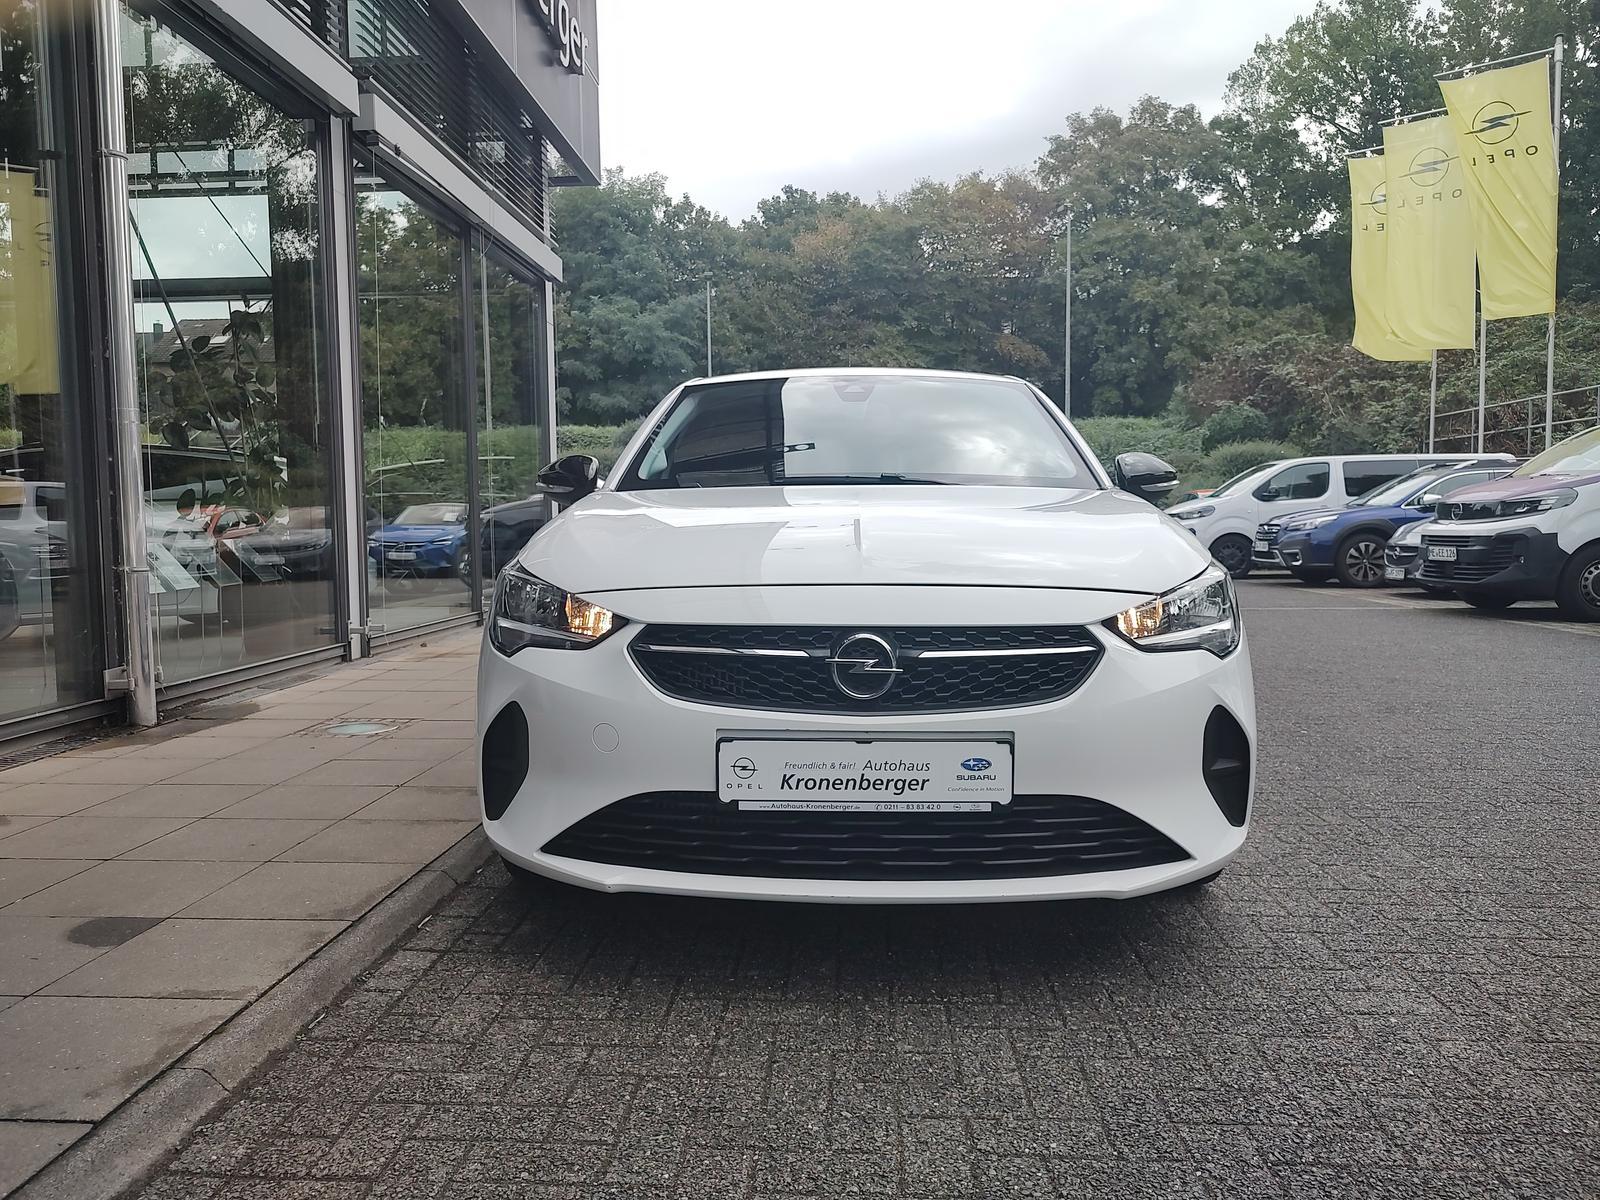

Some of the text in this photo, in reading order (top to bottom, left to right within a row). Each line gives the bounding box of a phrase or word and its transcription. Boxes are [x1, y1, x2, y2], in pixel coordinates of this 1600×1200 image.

[784, 759, 931, 772] Freundlich & fair! Autohaus
[726, 782, 763, 790] OPEL
[780, 773, 930, 796] Kronenberger
